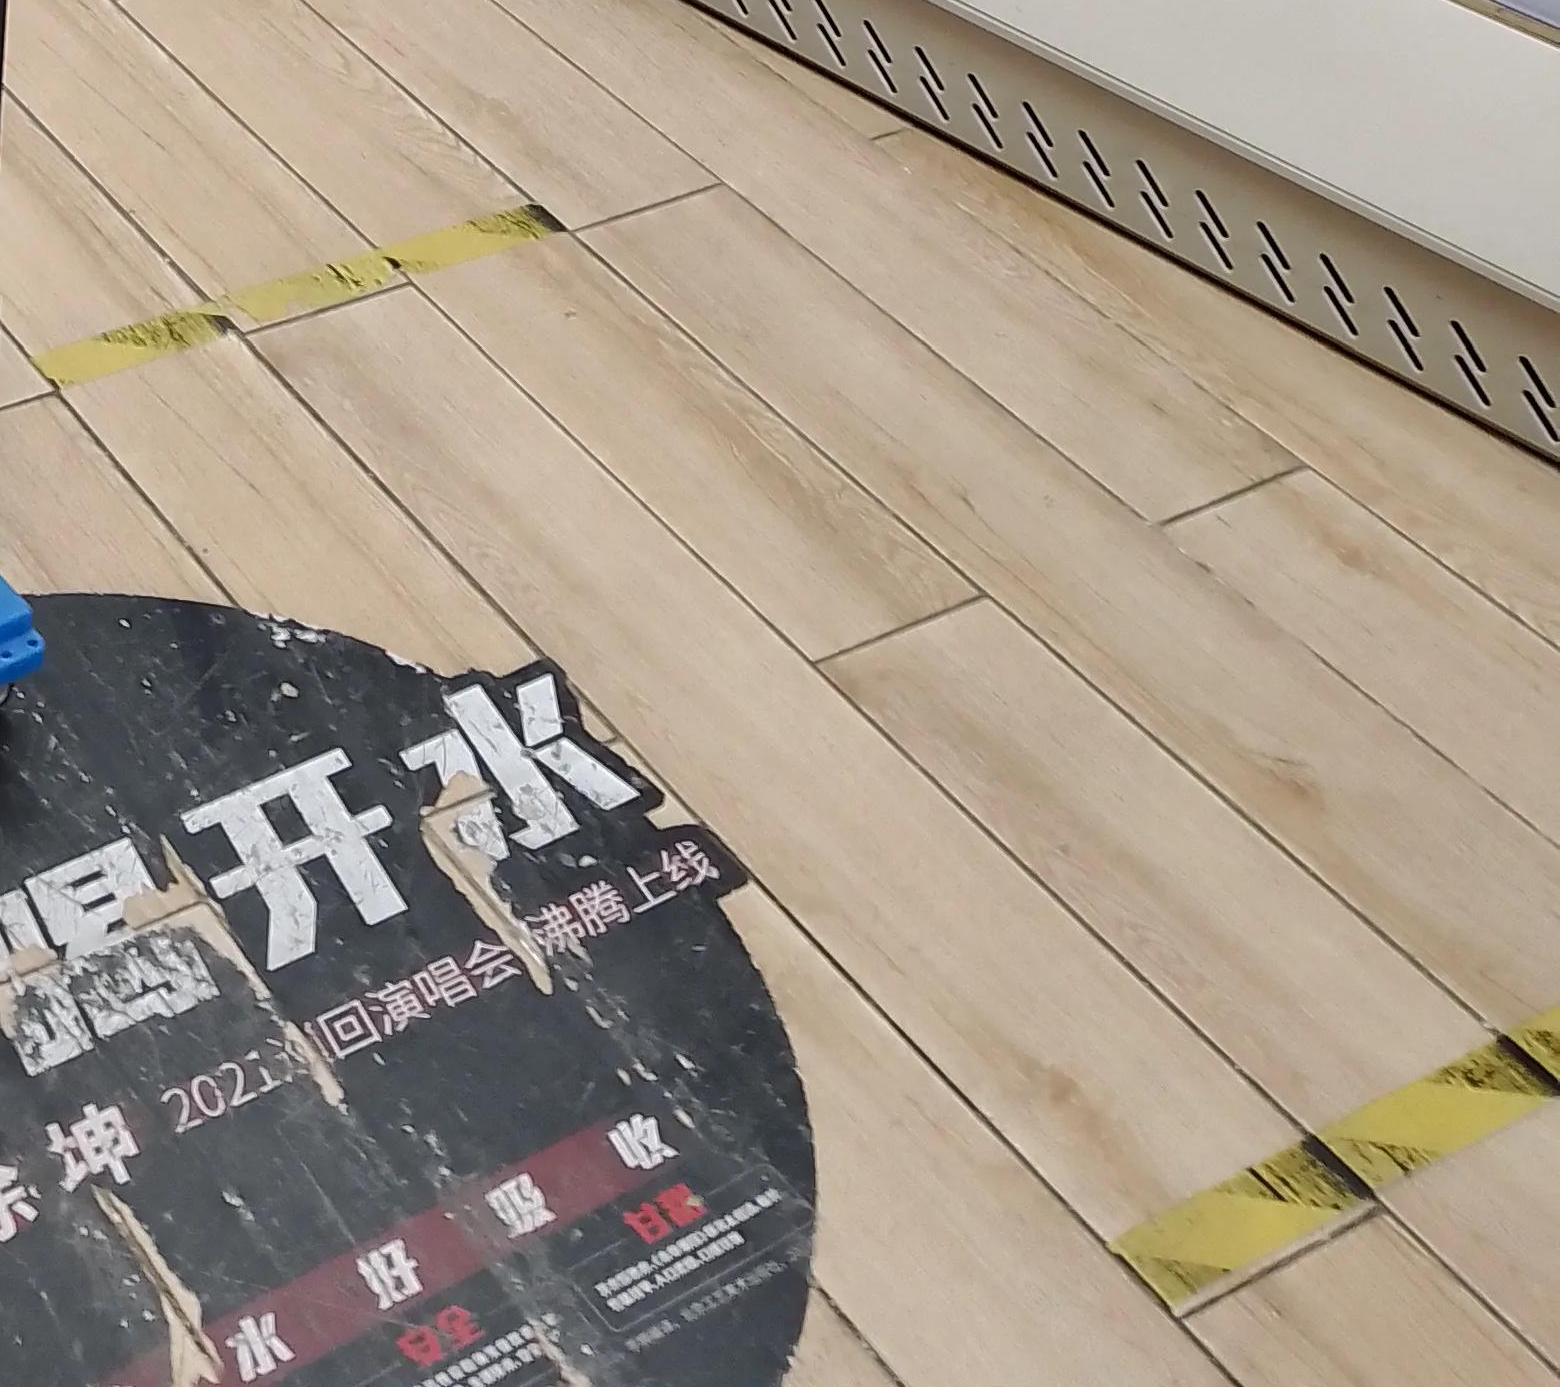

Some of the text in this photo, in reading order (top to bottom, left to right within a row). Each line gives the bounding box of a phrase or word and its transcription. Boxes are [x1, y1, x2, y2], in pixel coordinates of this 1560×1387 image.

[525, 835, 725, 960] 沸腾上线
[159, 938, 524, 1137] 2021回演唱会
